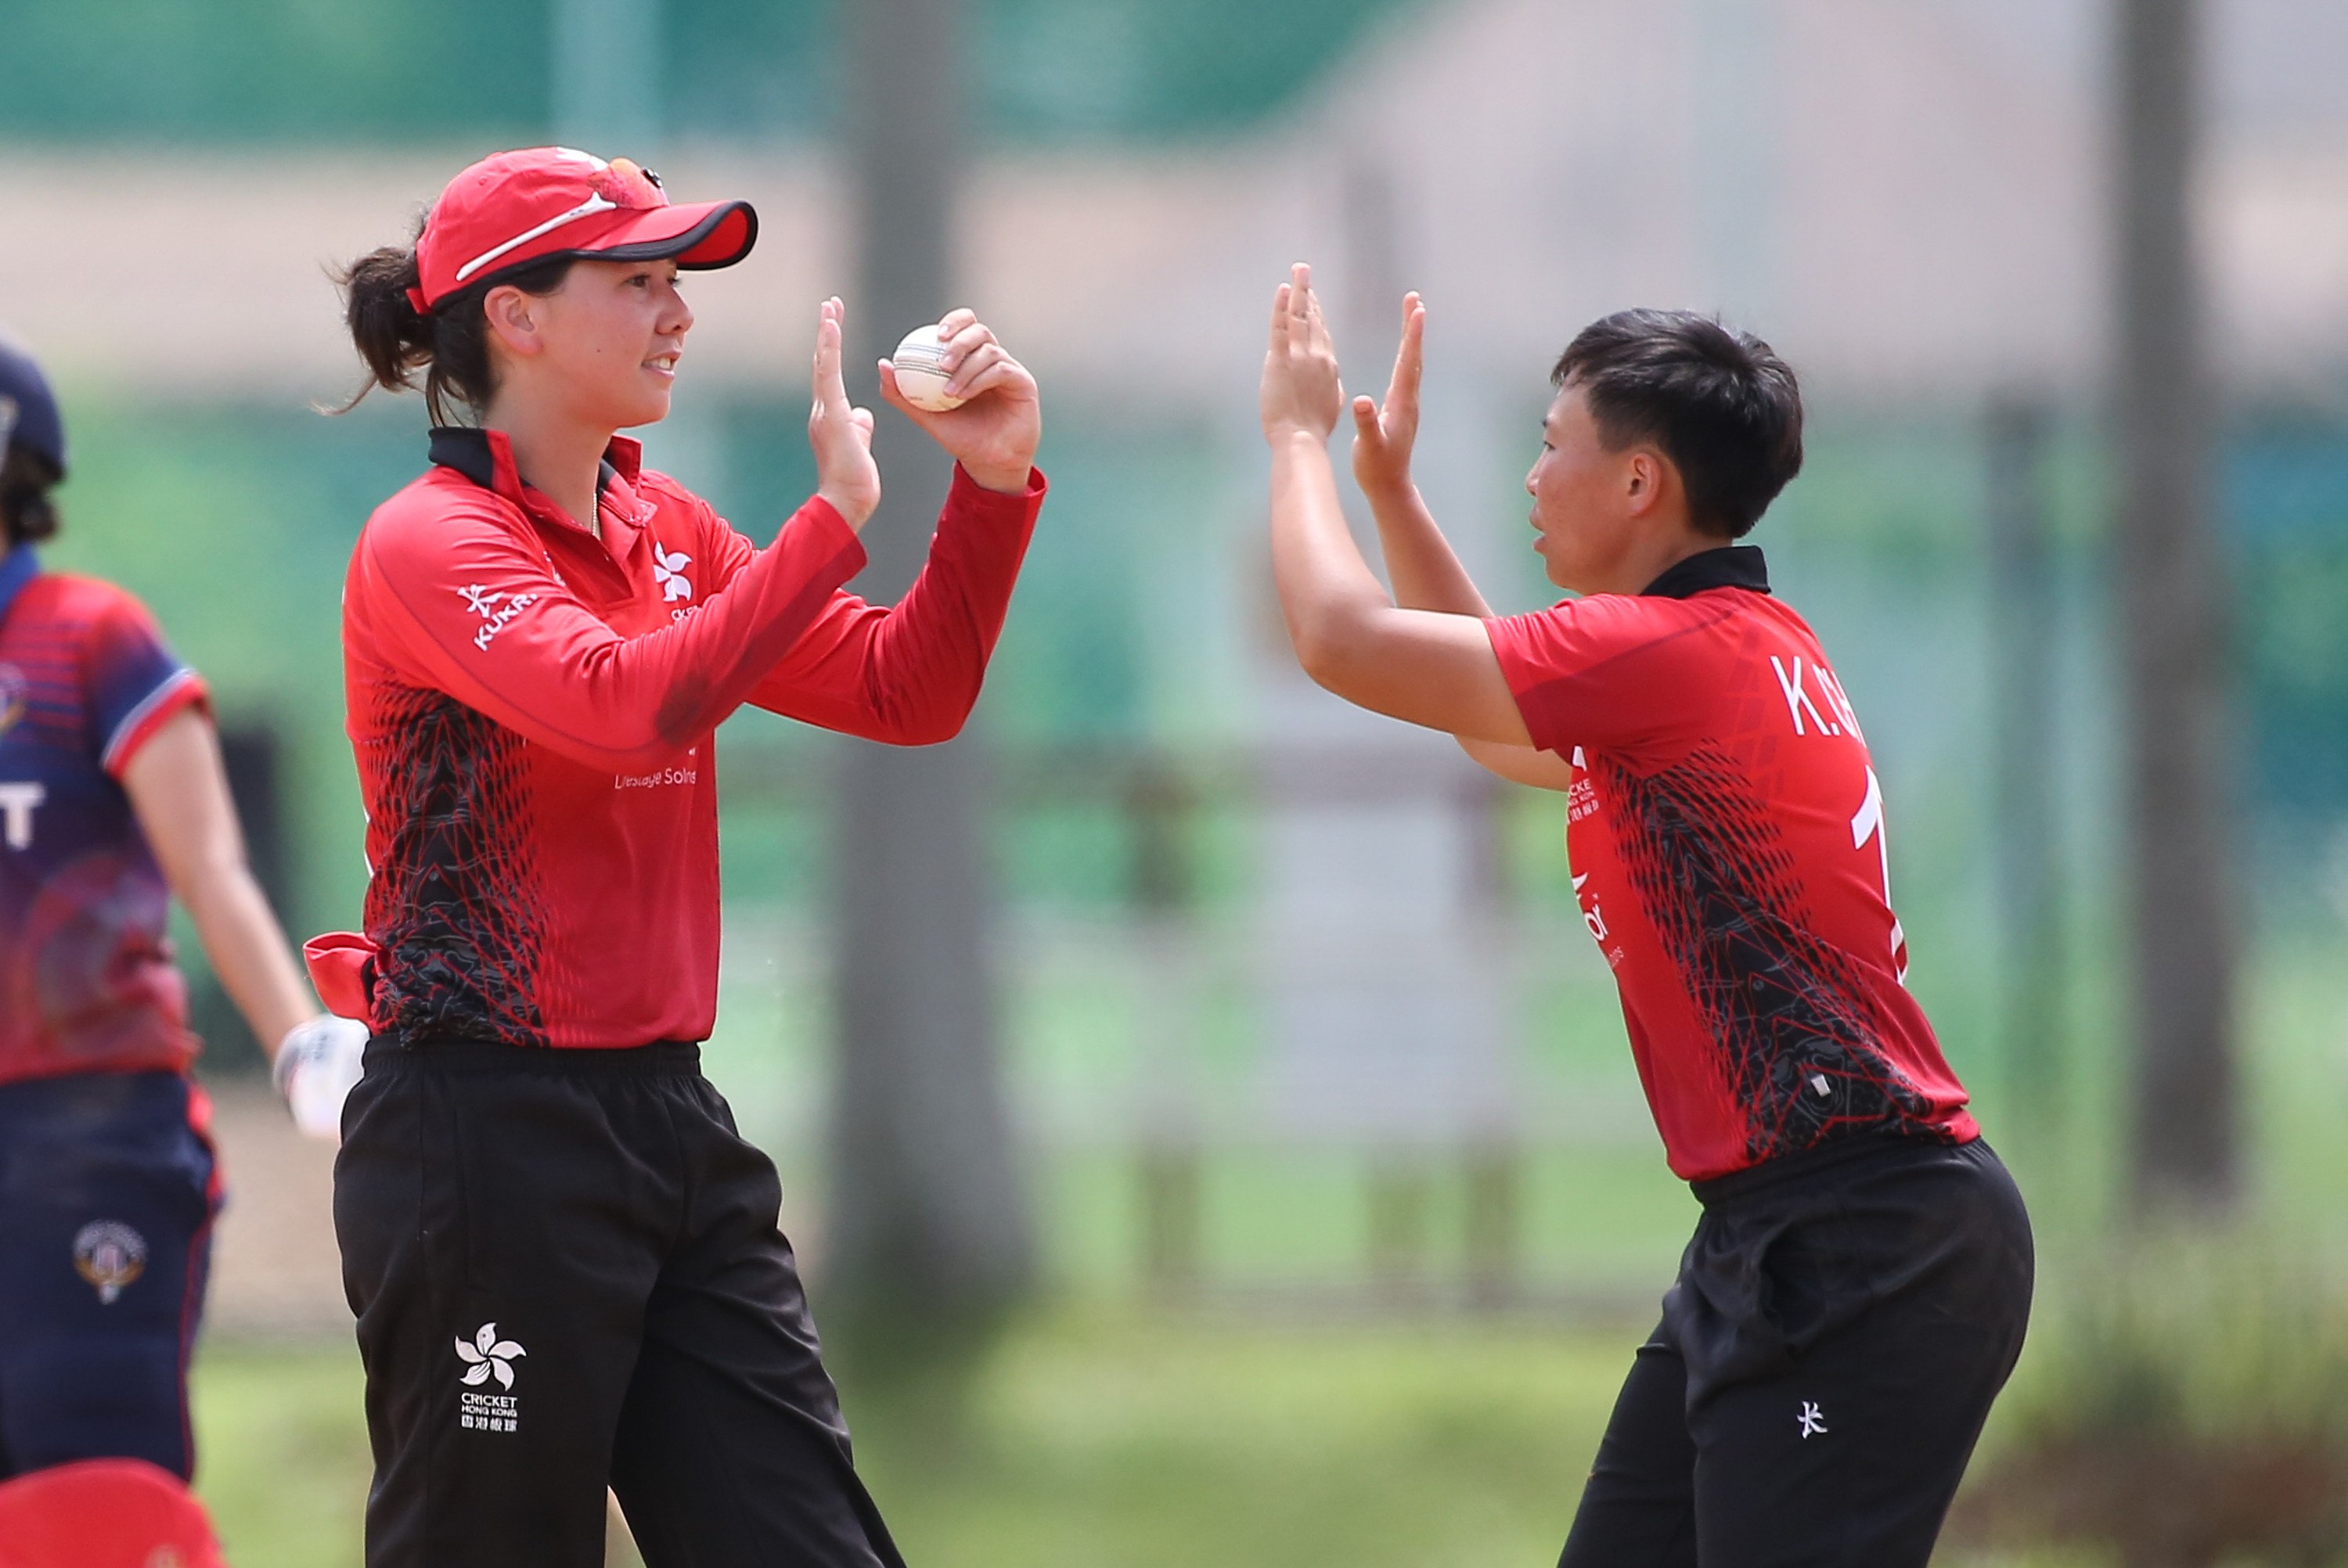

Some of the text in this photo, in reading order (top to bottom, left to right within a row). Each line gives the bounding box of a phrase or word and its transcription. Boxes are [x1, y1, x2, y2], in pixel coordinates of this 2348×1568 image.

[461, 1392, 518, 1408] CRICKET
[462, 1404, 517, 1418] HONG KONG
